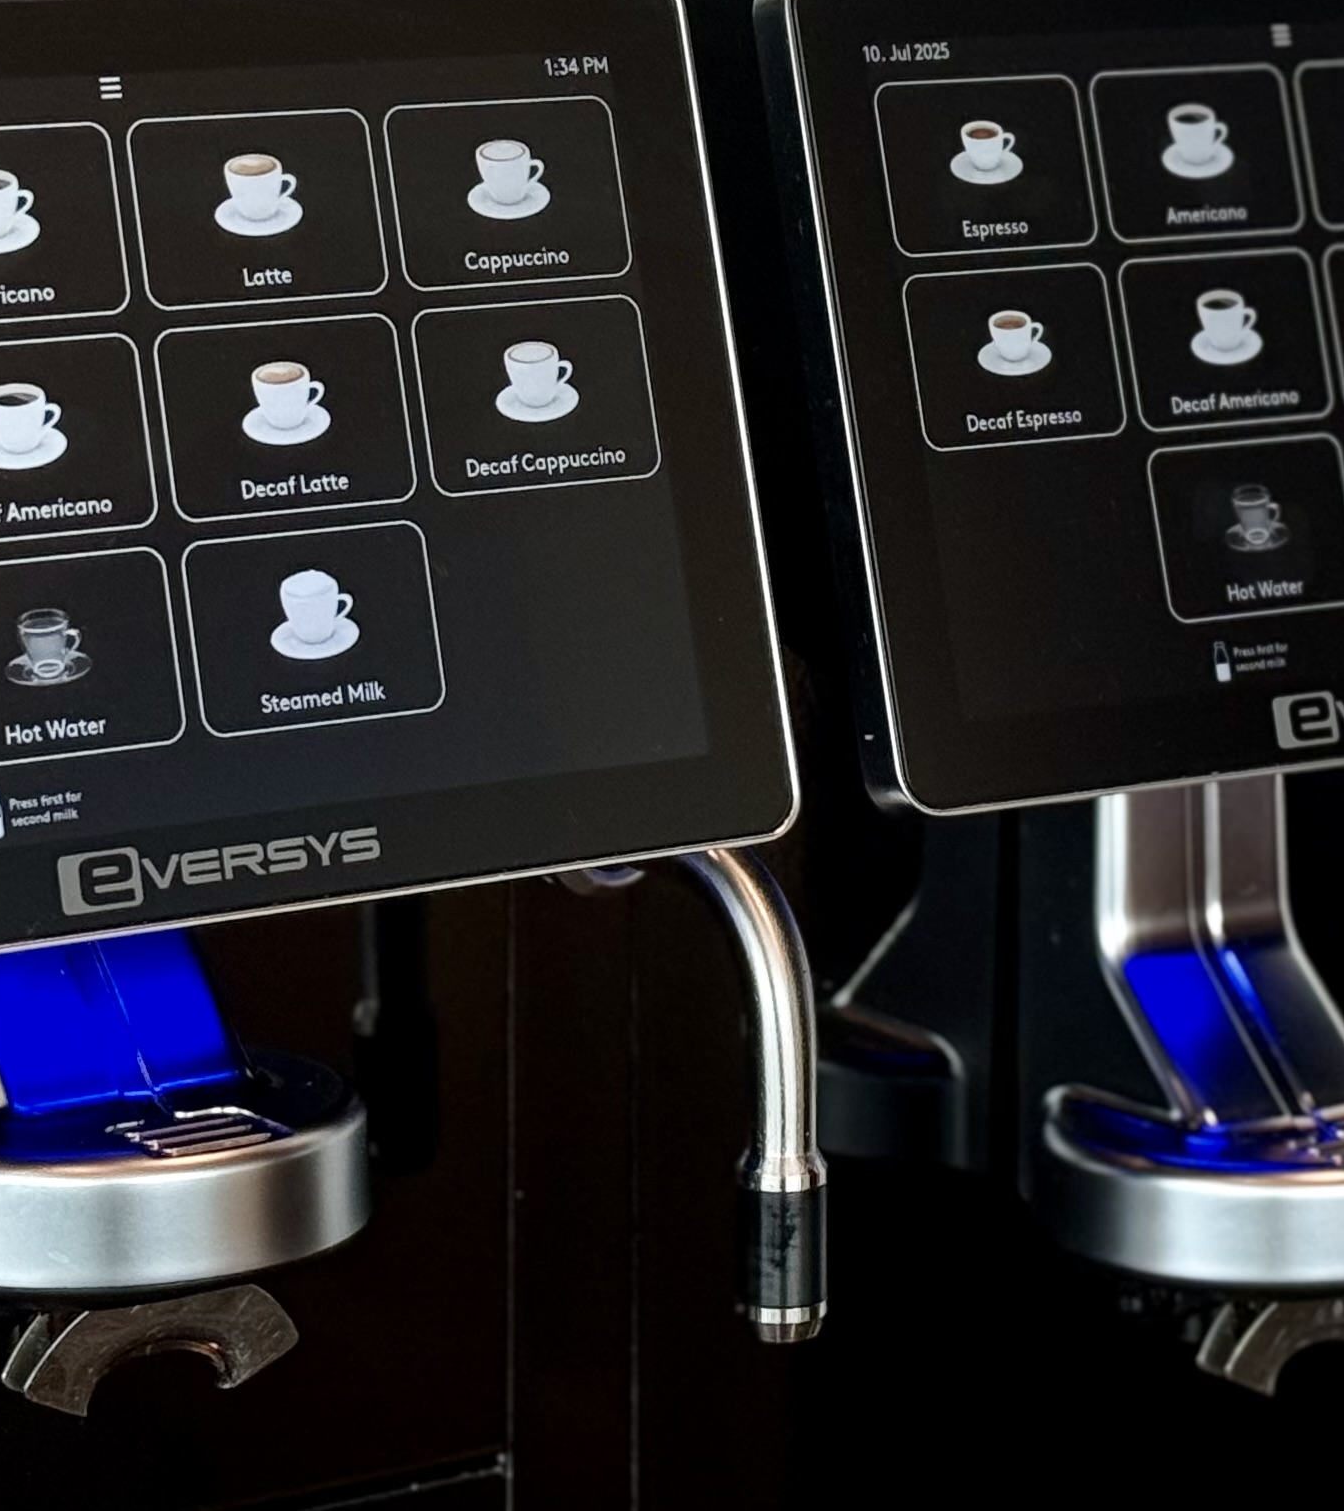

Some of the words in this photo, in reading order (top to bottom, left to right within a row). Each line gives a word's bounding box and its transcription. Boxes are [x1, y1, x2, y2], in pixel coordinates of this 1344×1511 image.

[863, 45, 886, 62] 10.
[890, 44, 911, 61] Jul
[914, 42, 949, 60] 2025
[545, 58, 579, 76] 1:34
[583, 57, 608, 74] PM
[1167, 207, 1247, 224] Americano
[962, 220, 1028, 241] Espresso
[464, 246, 570, 273] Cappuccino
[243, 268, 292, 286] Latte
[1171, 393, 1216, 414] Decaf
[1219, 391, 1299, 409] Americano
[967, 411, 1013, 432] Decaf
[1016, 410, 1081, 431] Espresso
[466, 455, 518, 477] Decaf
[521, 446, 626, 474] Cappuccino
[241, 476, 295, 500] Decaf
[300, 475, 348, 494] Latte
[6, 498, 112, 522] Americano
[1227, 584, 1256, 601] Hot
[1257, 580, 1303, 597] Water
[261, 686, 343, 713] Steamed
[348, 681, 386, 703] Milk
[5, 724, 43, 745] Hot
[45, 719, 106, 739] Water
[9, 798, 38, 810] Press
[40, 794, 63, 806] first
[65, 792, 82, 803] for
[11, 812, 50, 826] second
[52, 807, 79, 821] milk
